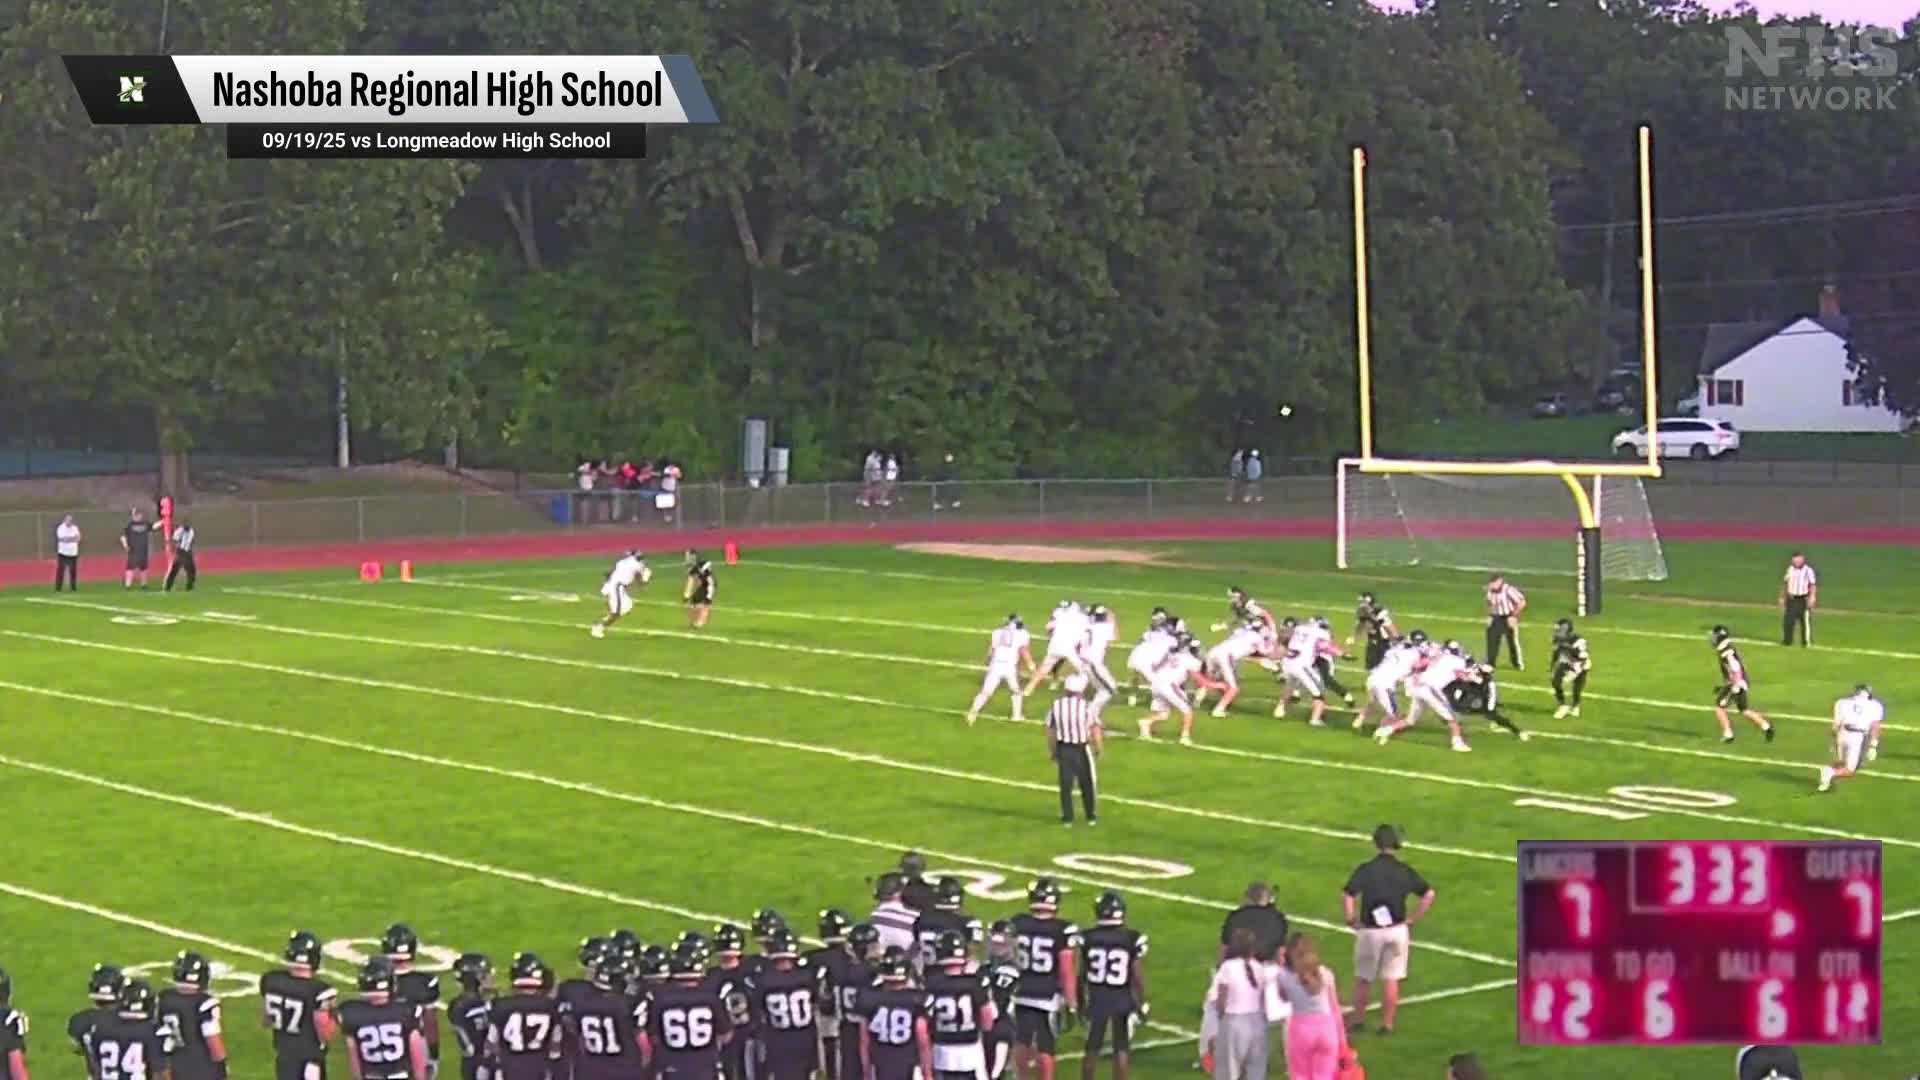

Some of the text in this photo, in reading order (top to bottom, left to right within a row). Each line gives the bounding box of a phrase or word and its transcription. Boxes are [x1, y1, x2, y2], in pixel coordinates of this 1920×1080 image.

[1513, 785, 1740, 820] 10
[1087, 948, 1129, 985] 33
[265, 994, 304, 1033] 57
[663, 1007, 713, 1048] 66
[766, 989, 812, 1029] 80
[869, 1006, 912, 1045] 48
[935, 995, 976, 1032] 21
[357, 1023, 404, 1062] 25
[503, 1012, 551, 1051] 47
[580, 1016, 621, 1054] 61
[99, 1041, 147, 1080] 24
